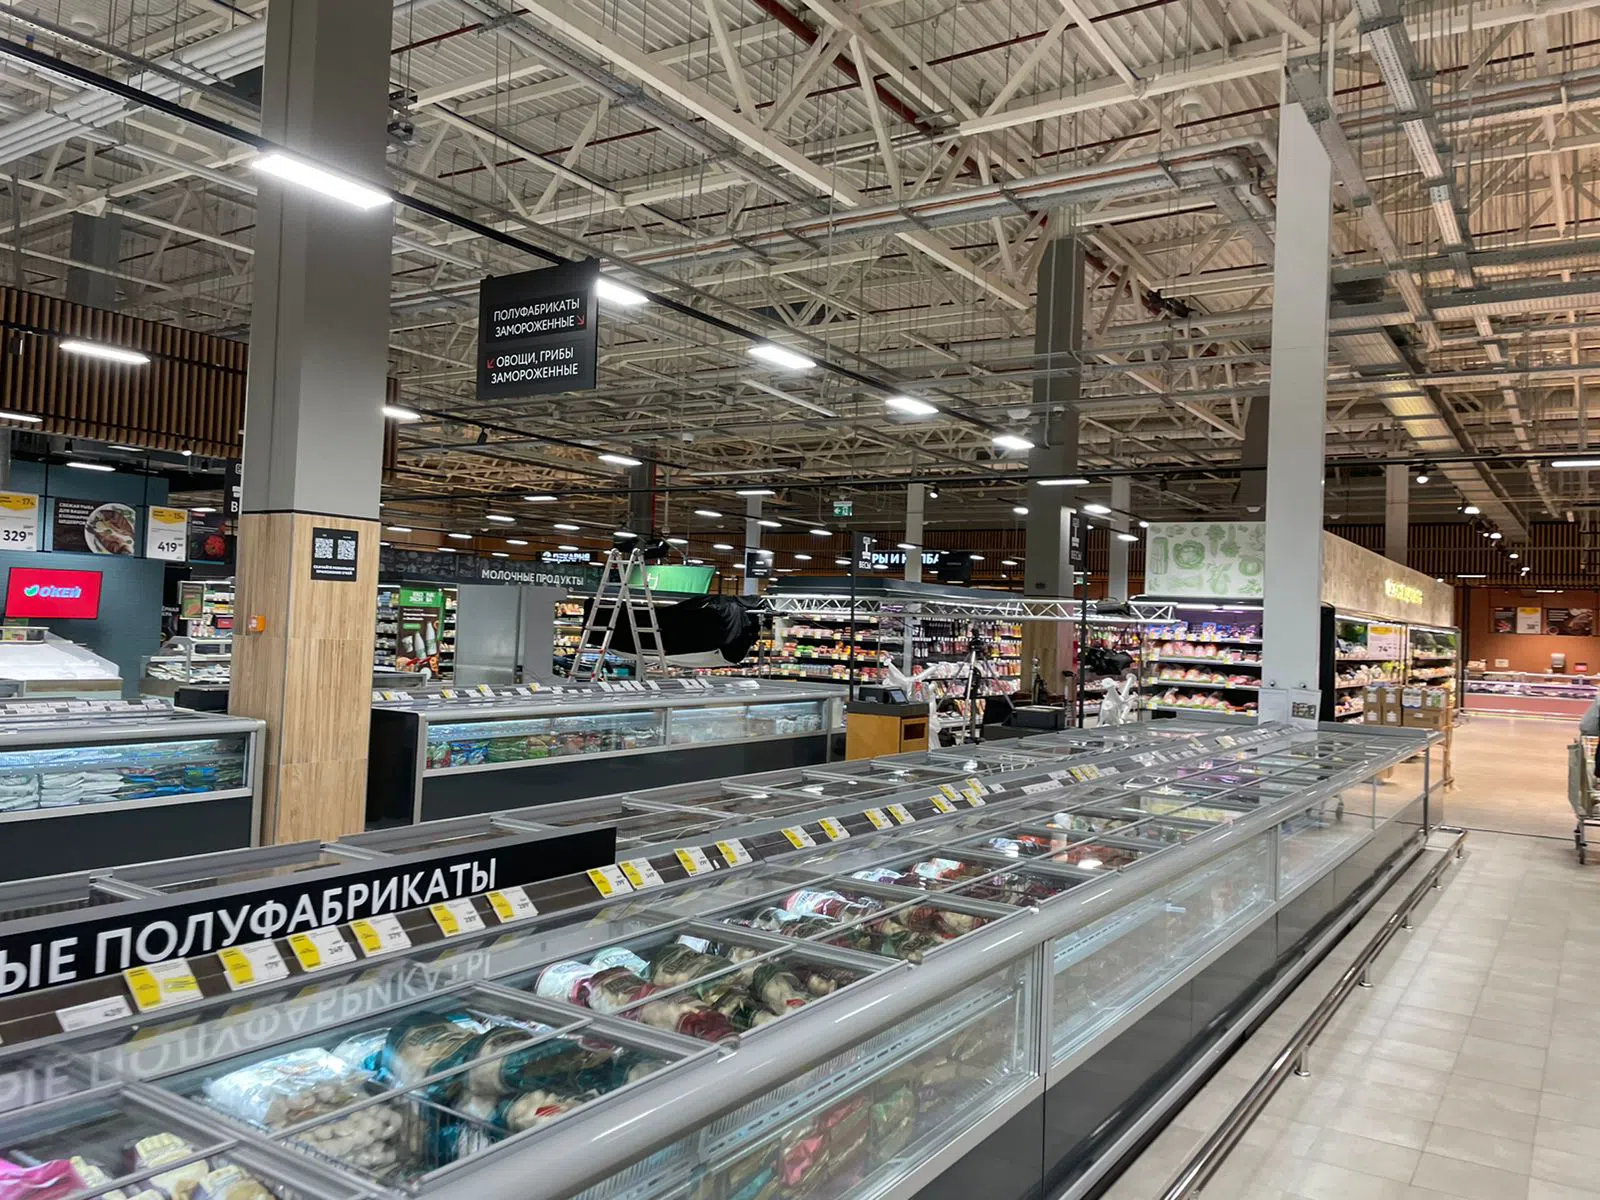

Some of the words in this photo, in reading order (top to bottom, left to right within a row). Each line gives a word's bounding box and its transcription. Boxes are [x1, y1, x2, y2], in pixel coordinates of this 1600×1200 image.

[493, 298, 580, 322] ПОЛУФАБРИКАТЫ
[495, 315, 575, 338] ЗАМОРОЖЕННЫЕ
[496, 352, 538, 368] ОВОЩИ,
[540, 347, 574, 363] ГРИБЫ
[491, 363, 579, 384] ЗАМОРОЖЕННЫЕ
[3, 530, 27, 541] 329
[158, 541, 178, 552] 419
[552, 553, 590, 564] ПЕКАРНЯ
[890, 554, 899, 564] И
[481, 569, 536, 582] МОЛОЧНЫЕ
[536, 573, 584, 586] ПРОДУКТЫ
[0, 936, 79, 995] ЫЕ
[94, 857, 497, 974] ПОЛУФАБРИКАТЫ
